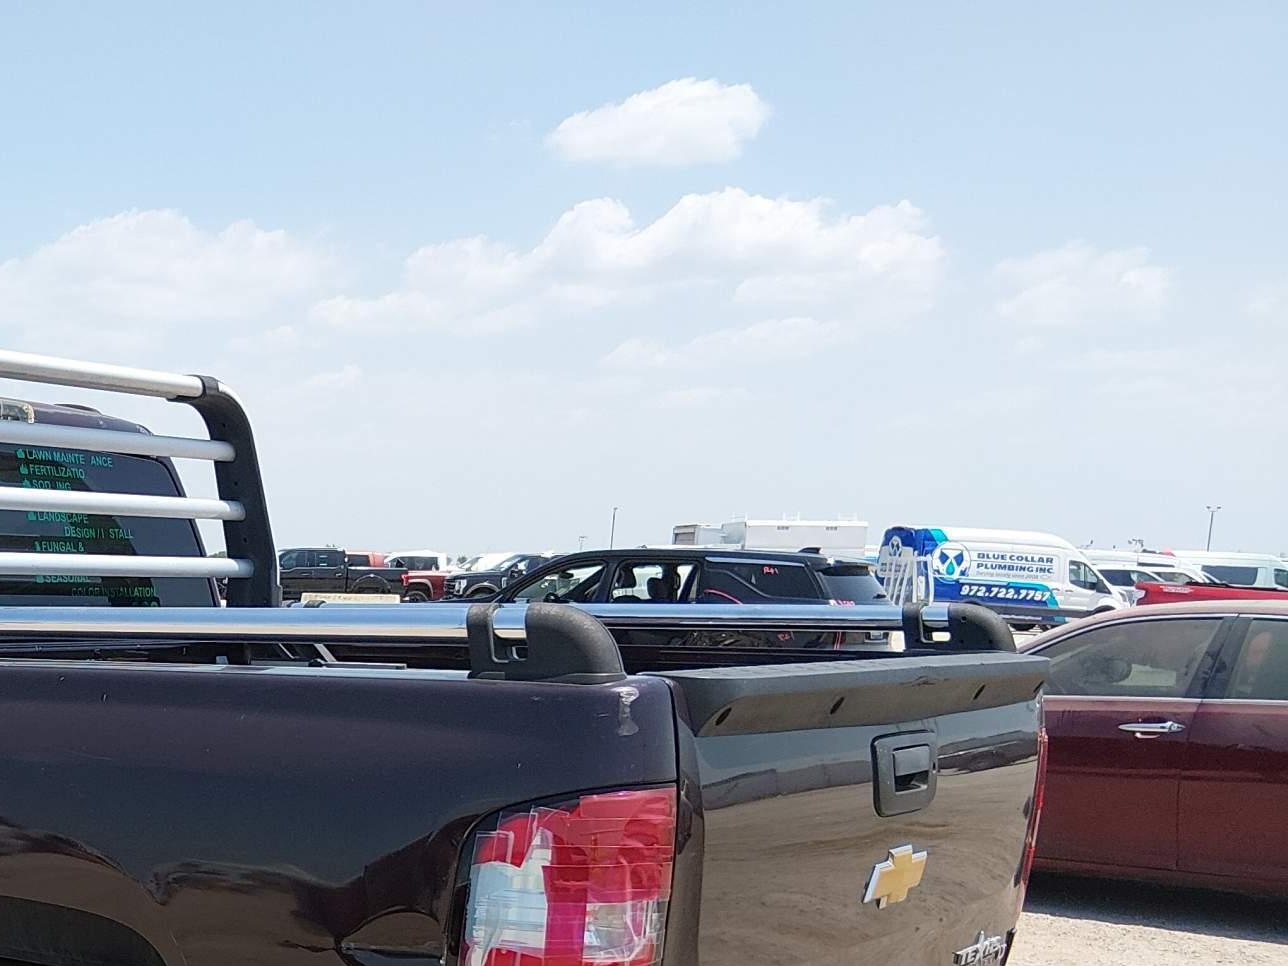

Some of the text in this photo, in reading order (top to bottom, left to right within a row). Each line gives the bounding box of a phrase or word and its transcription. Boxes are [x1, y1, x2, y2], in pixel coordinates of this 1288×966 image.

[26, 449, 52, 461] LAWN
[37, 511, 89, 524] LANDSCAPE
[42, 541, 77, 552] FUNGAL
[977, 552, 1054, 564] BLUE COLLAR
[976, 563, 1033, 573] PLUMBING
[960, 584, 1051, 602] 972.722.7757
